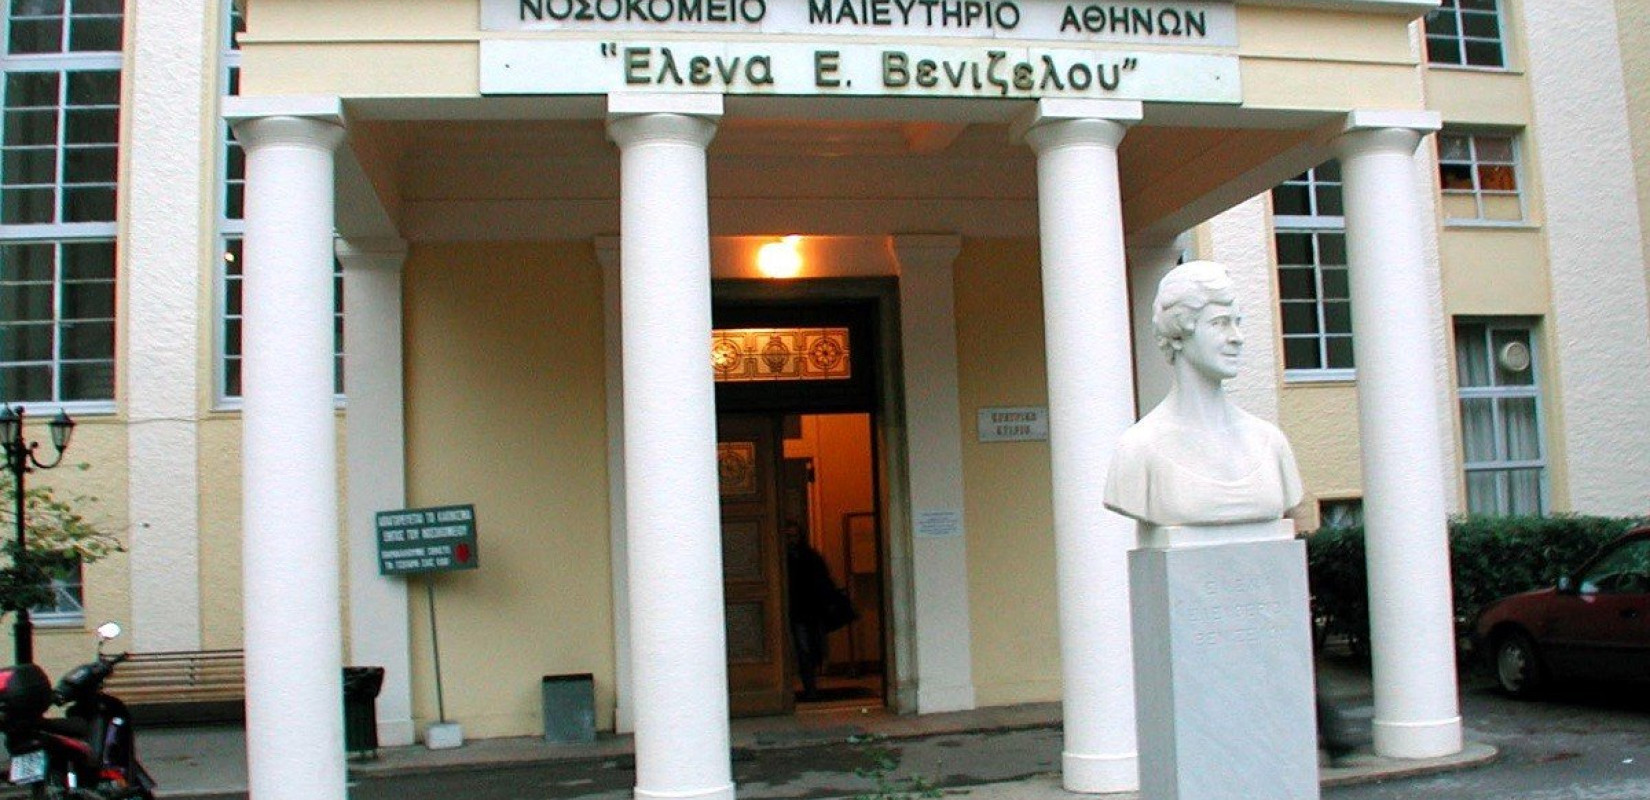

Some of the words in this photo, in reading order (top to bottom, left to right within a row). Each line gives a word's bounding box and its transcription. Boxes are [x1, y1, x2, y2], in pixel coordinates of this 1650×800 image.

[519, 0, 767, 23] ΝΟΣΟΚΟΜΕΙΟ
[808, 0, 1021, 30] ΜΑΙΕΥΤΗΡΙΟ
[1060, 4, 1207, 37] ΑΘΗΝΩΝ
